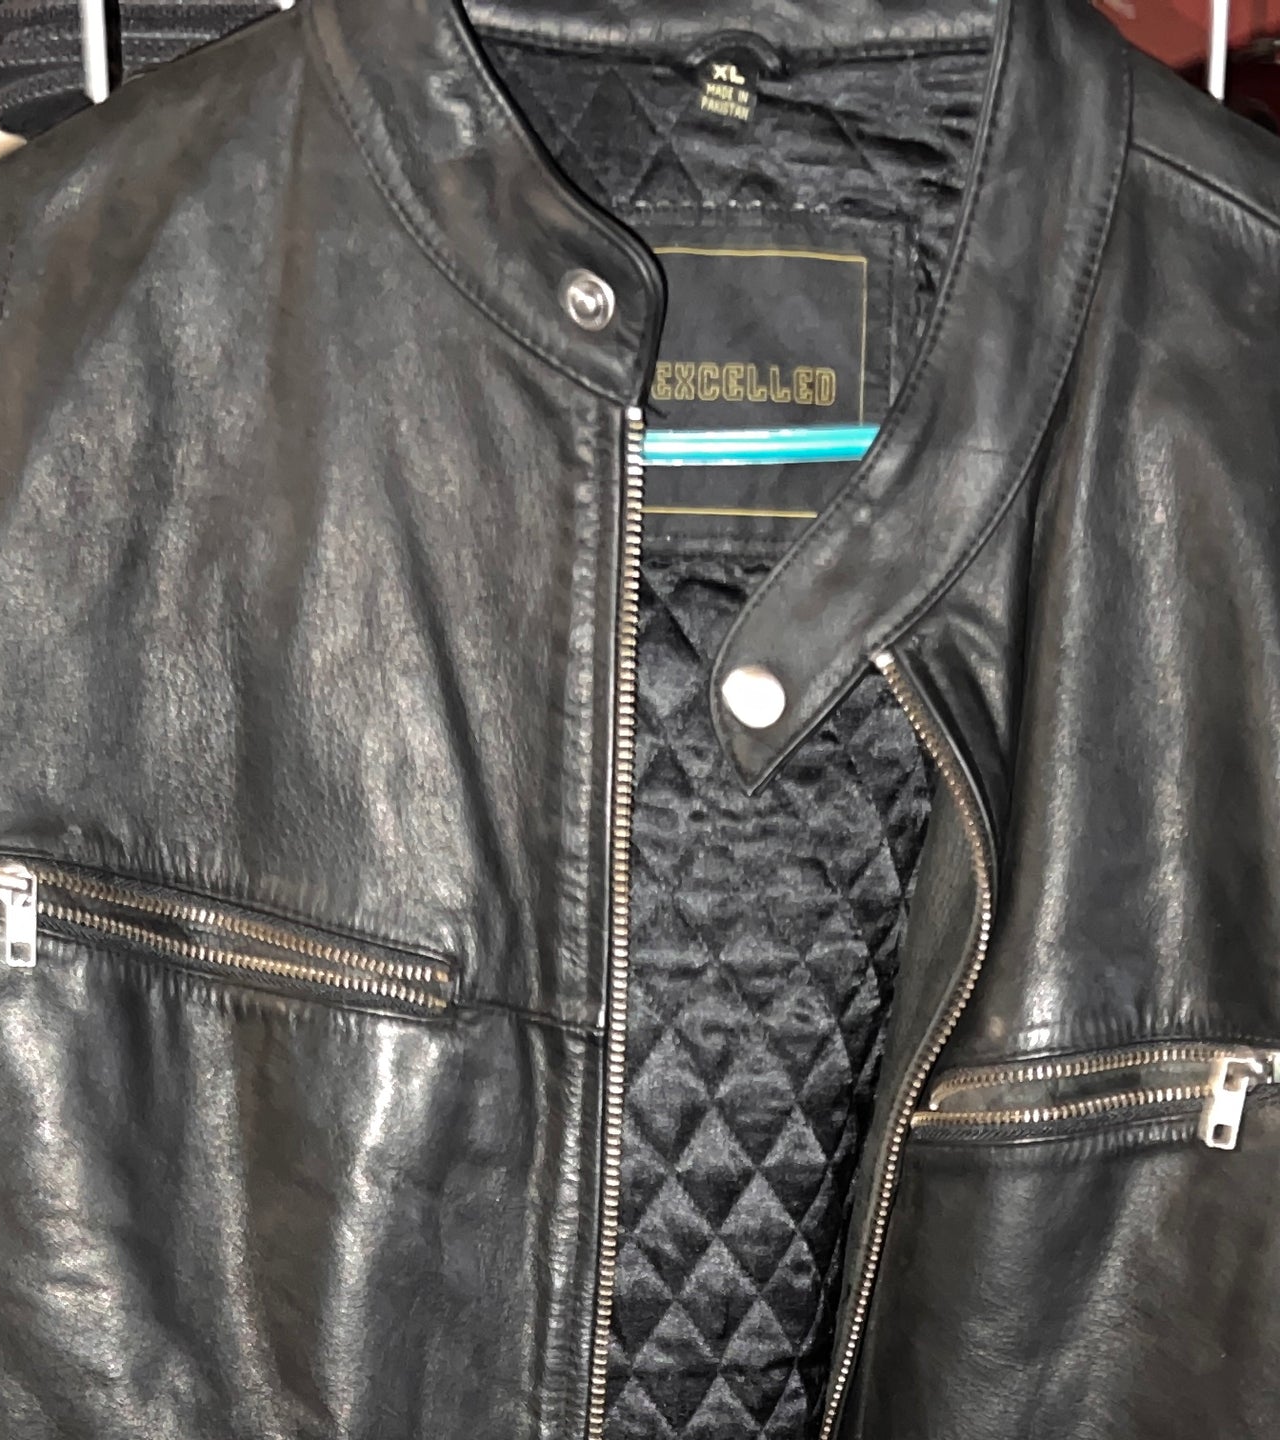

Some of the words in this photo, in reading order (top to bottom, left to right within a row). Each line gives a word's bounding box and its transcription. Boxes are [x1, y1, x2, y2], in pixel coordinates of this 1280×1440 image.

[712, 64, 745, 85] XL
[706, 83, 734, 100] MADE
[738, 90, 749, 103] IN
[651, 361, 836, 406] EXCELLED
